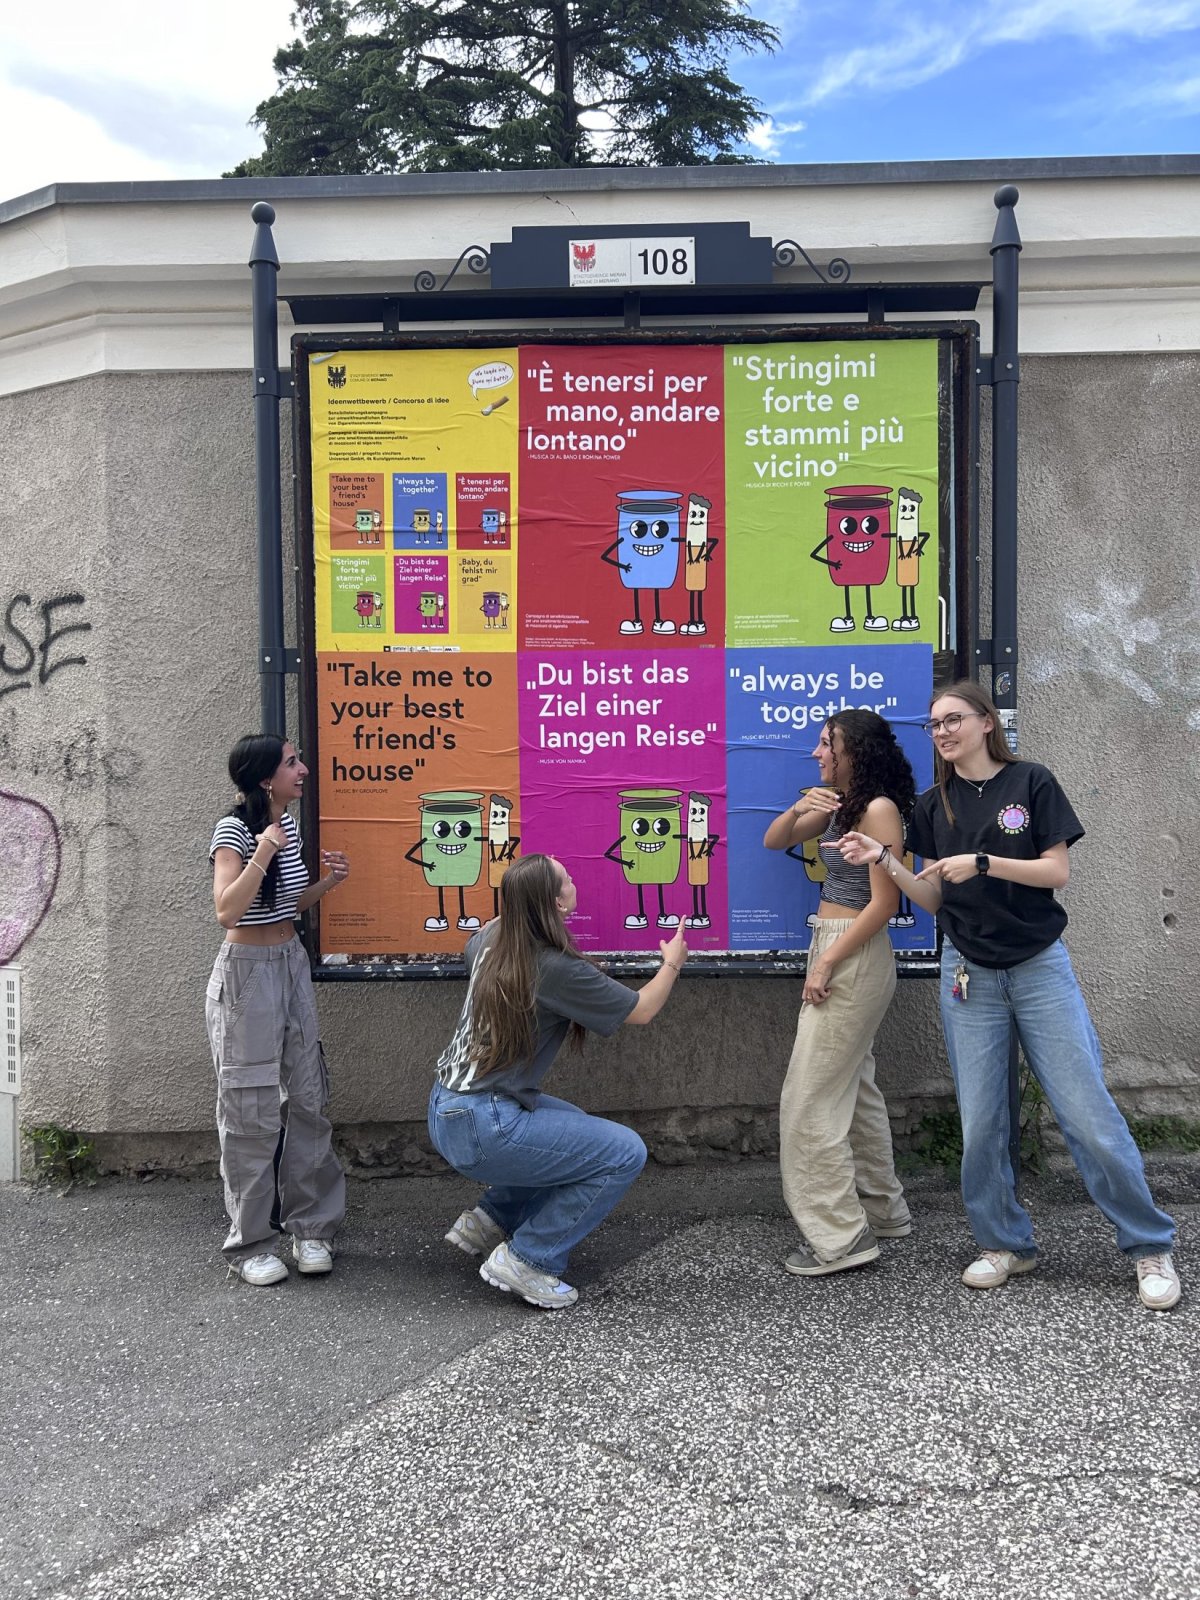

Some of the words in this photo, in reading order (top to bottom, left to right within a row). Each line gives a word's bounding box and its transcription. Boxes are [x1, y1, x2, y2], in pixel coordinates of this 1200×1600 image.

[638, 248, 688, 276] 108
[528, 360, 554, 392] "È
[562, 368, 654, 392] tenersi
[664, 374, 708, 399] per
[732, 352, 876, 386] "Stringimi
[546, 404, 625, 426] mano,
[630, 398, 720, 422] andare
[762, 387, 834, 413] forte
[843, 394, 860, 411] e
[527, 426, 637, 451] lontano"
[744, 419, 850, 446] stammi
[861, 416, 904, 451] più
[753, 452, 850, 478] vicino"
[395, 478, 424, 486] "always
[402, 486, 438, 495] together"
[332, 558, 370, 566] "Stringimi
[400, 574, 422, 582] langen
[327, 661, 402, 687] "Take
[412, 670, 453, 687] me
[462, 666, 493, 687] to
[582, 660, 634, 686] bist
[642, 659, 690, 684] das
[729, 666, 840, 698] "always
[850, 664, 884, 690] be
[330, 701, 394, 726] your
[404, 694, 465, 719] best
[538, 692, 586, 717] Ziel
[596, 693, 663, 716] einer
[352, 724, 456, 750] friend's
[539, 724, 626, 755] langen
[636, 722, 717, 747] Reise"
[332, 756, 425, 782] house"
